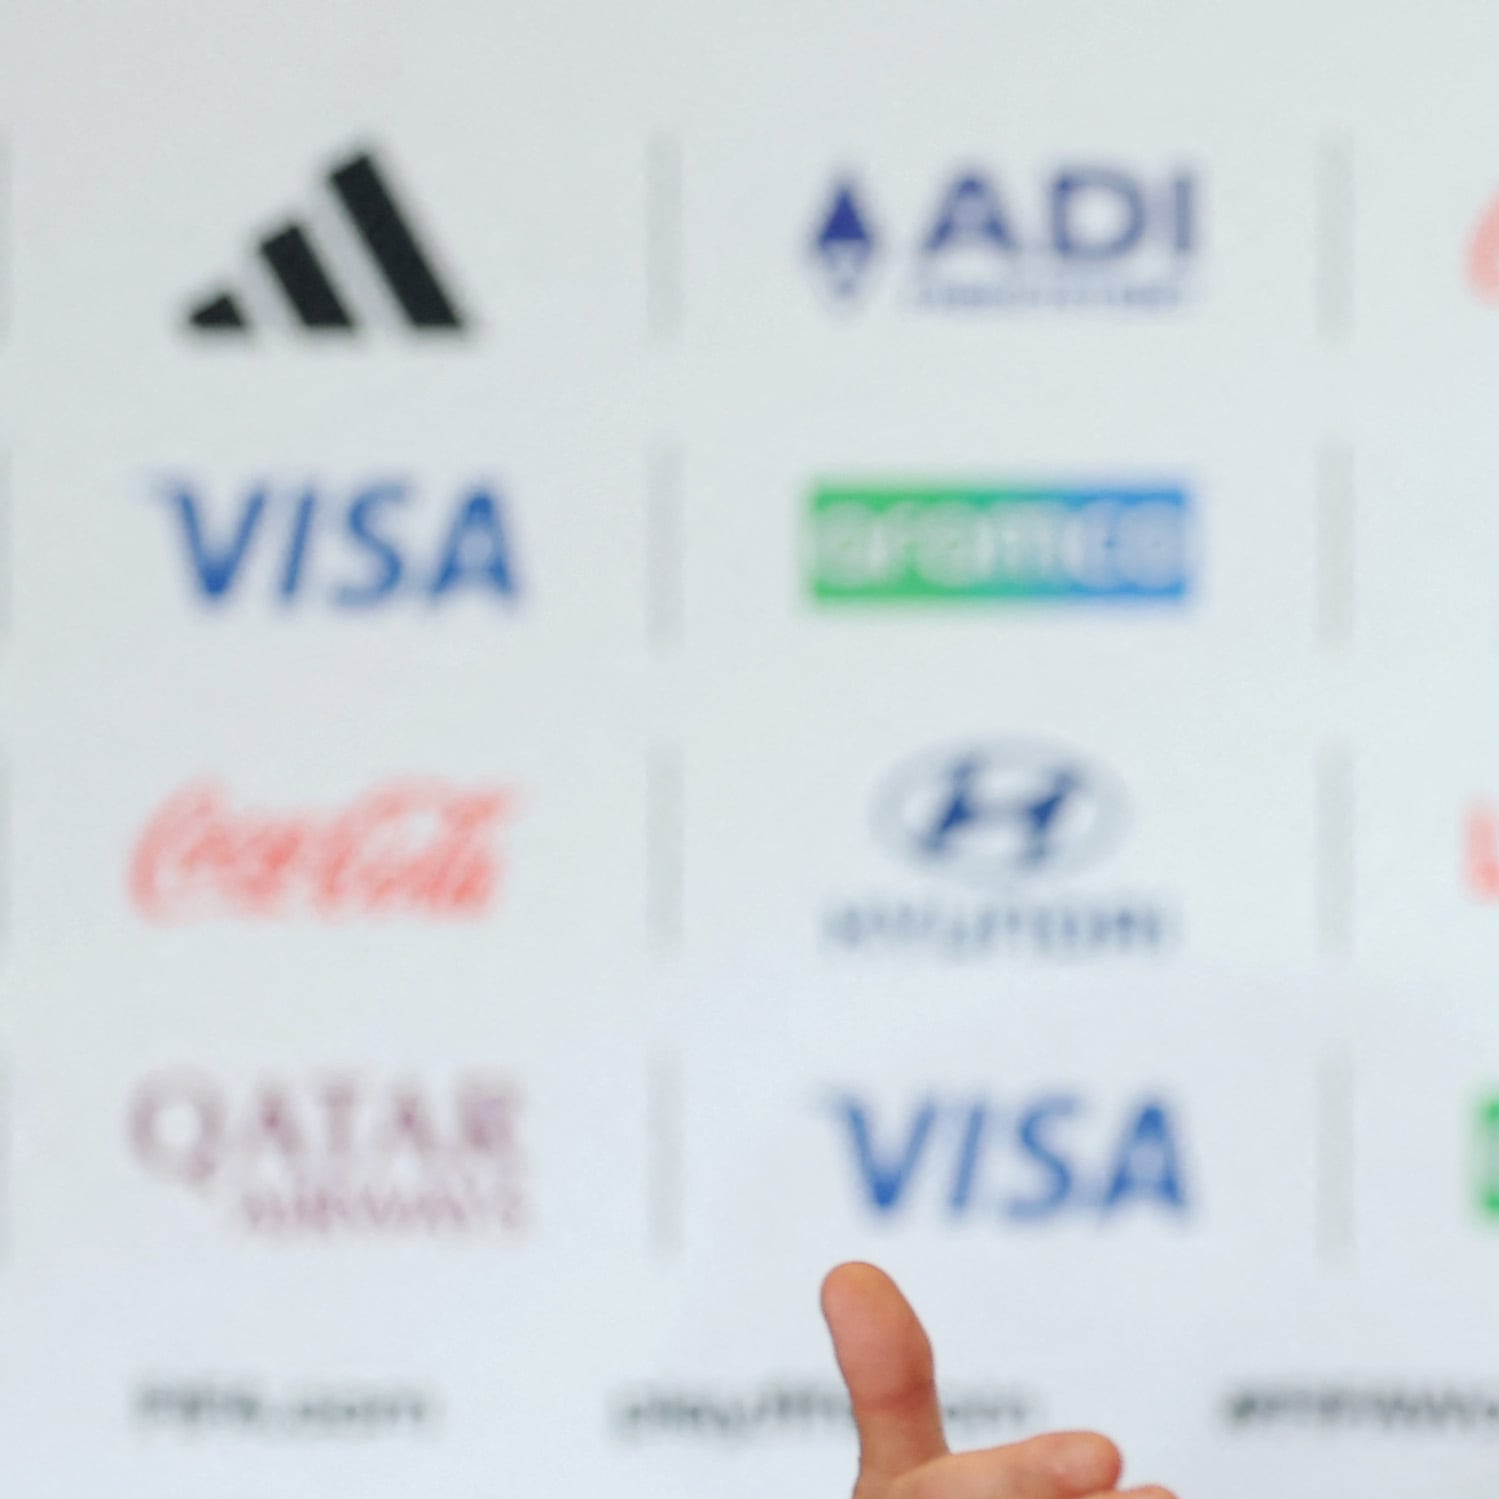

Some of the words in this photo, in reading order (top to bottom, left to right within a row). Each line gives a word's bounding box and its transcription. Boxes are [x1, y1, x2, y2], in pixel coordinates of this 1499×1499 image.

[916, 163, 1200, 262] ADI
[150, 478, 522, 611] VISA
[126, 1072, 522, 1190] QATAR
[825, 1092, 1192, 1224] VISA
